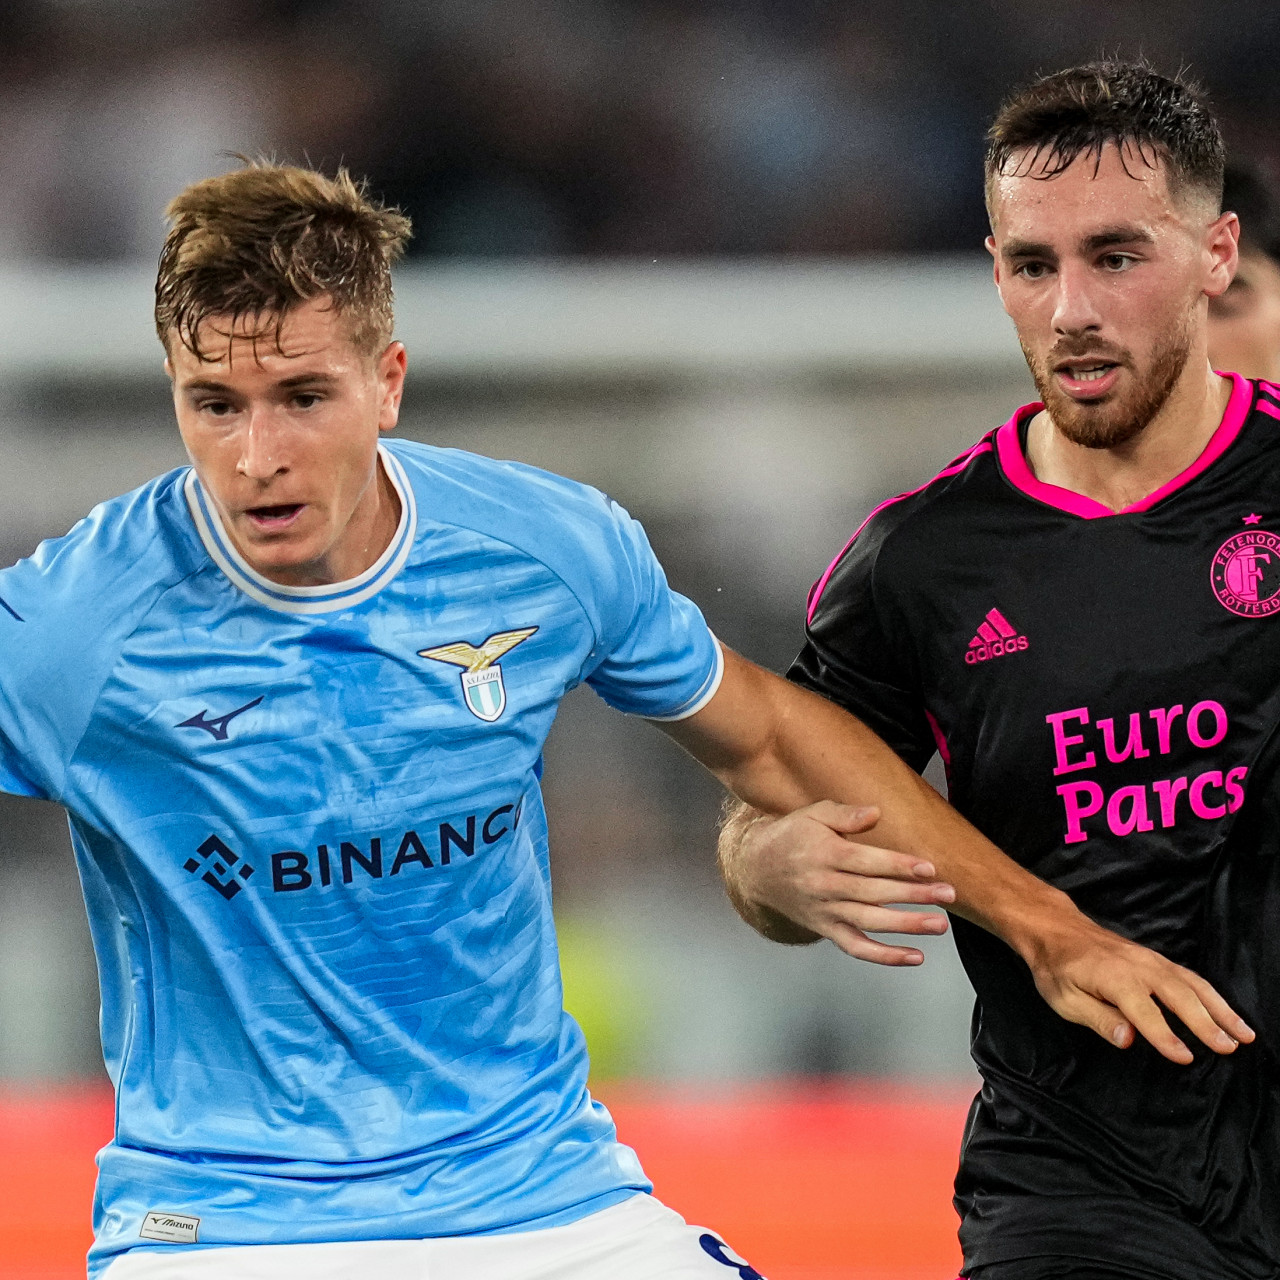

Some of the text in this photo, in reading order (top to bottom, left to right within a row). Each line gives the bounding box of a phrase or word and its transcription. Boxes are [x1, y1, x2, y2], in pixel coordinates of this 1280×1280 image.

[964, 635, 1029, 664] adidas
[1046, 699, 1228, 776] Euro
[1056, 766, 1248, 844] Parcs
[271, 795, 523, 893] BINANC
